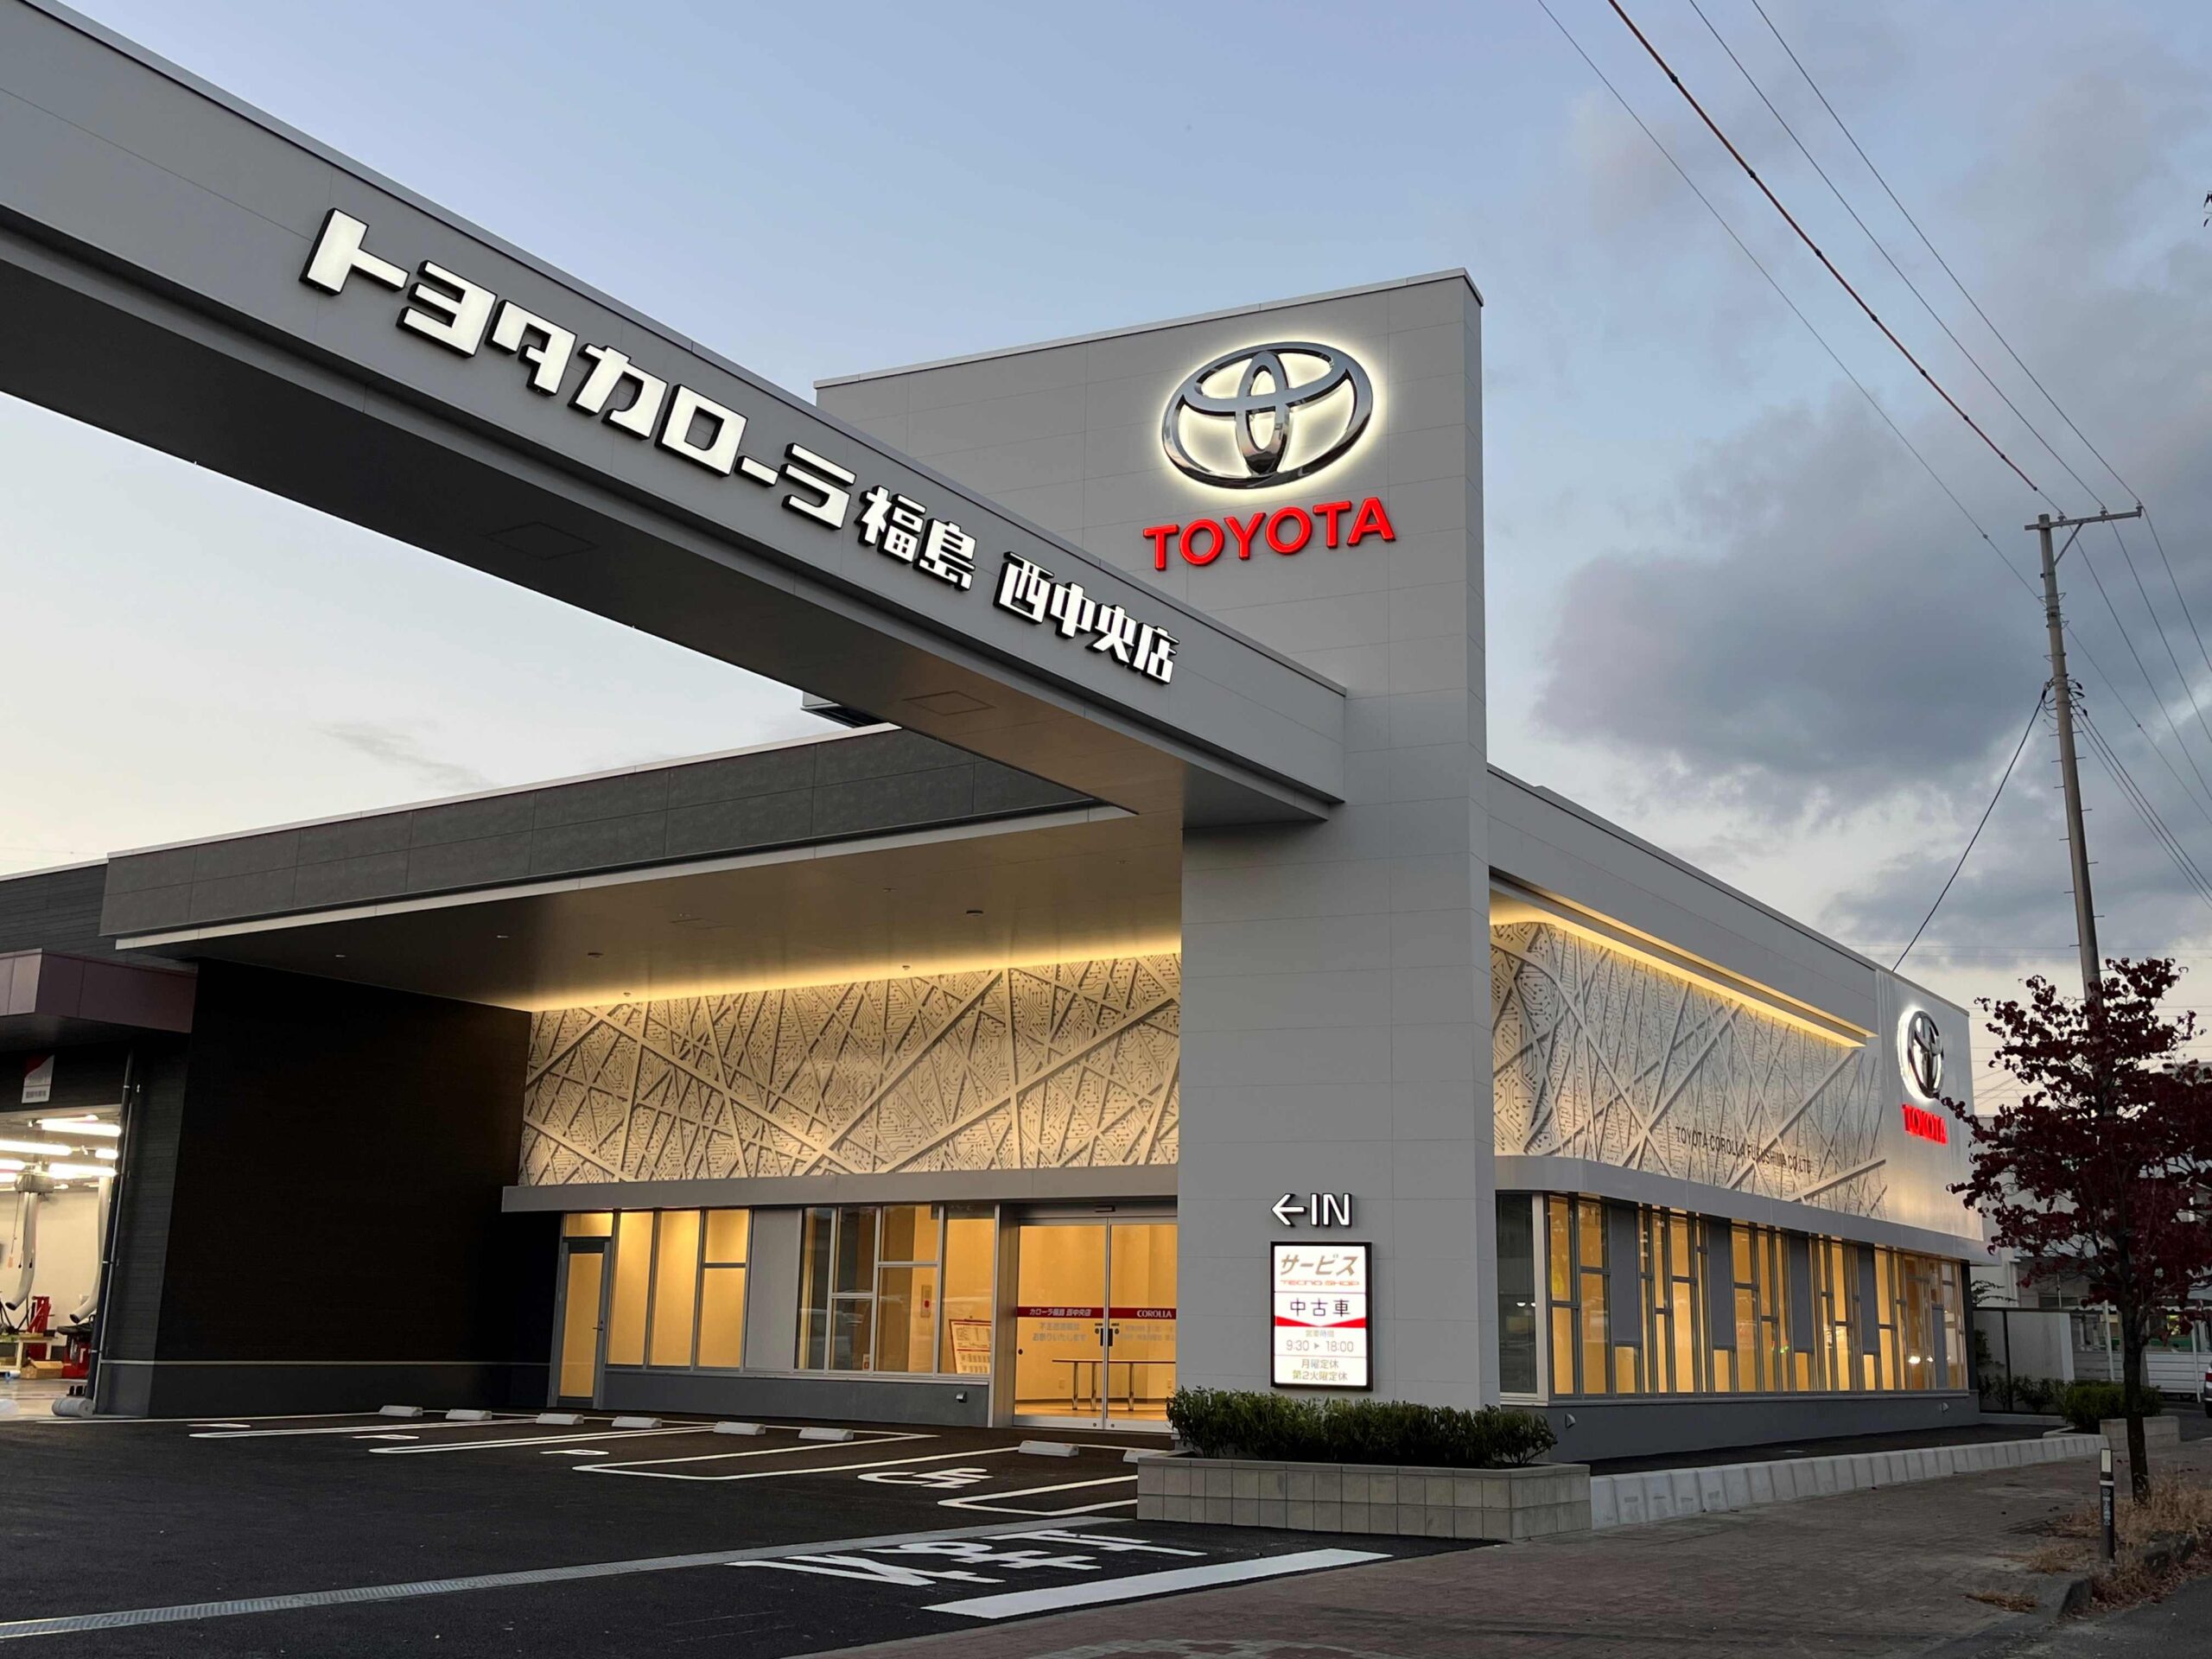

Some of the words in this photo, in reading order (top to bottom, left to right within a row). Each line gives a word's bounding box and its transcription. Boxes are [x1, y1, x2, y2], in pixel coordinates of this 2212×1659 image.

[300, 207, 977, 592] トヨタカローラ福島
[993, 550, 1180, 685] 西中央店
[1142, 496, 1397, 572] TOYOTA
[1902, 1103, 1948, 1147] TOYOTA
[1675, 1126, 1707, 1148] TOYOTA
[1311, 1192, 1352, 1228] IN
[1281, 1254, 1358, 1277] サービス
[1290, 1298, 1351, 1318] 中古車
[1286, 1339, 1310, 1351] 9:30
[1326, 1341, 1354, 1352] 18:00
[1301, 1359, 1339, 1370] 月曜定休
[1293, 1370, 1348, 1382] 第2火曜定休
